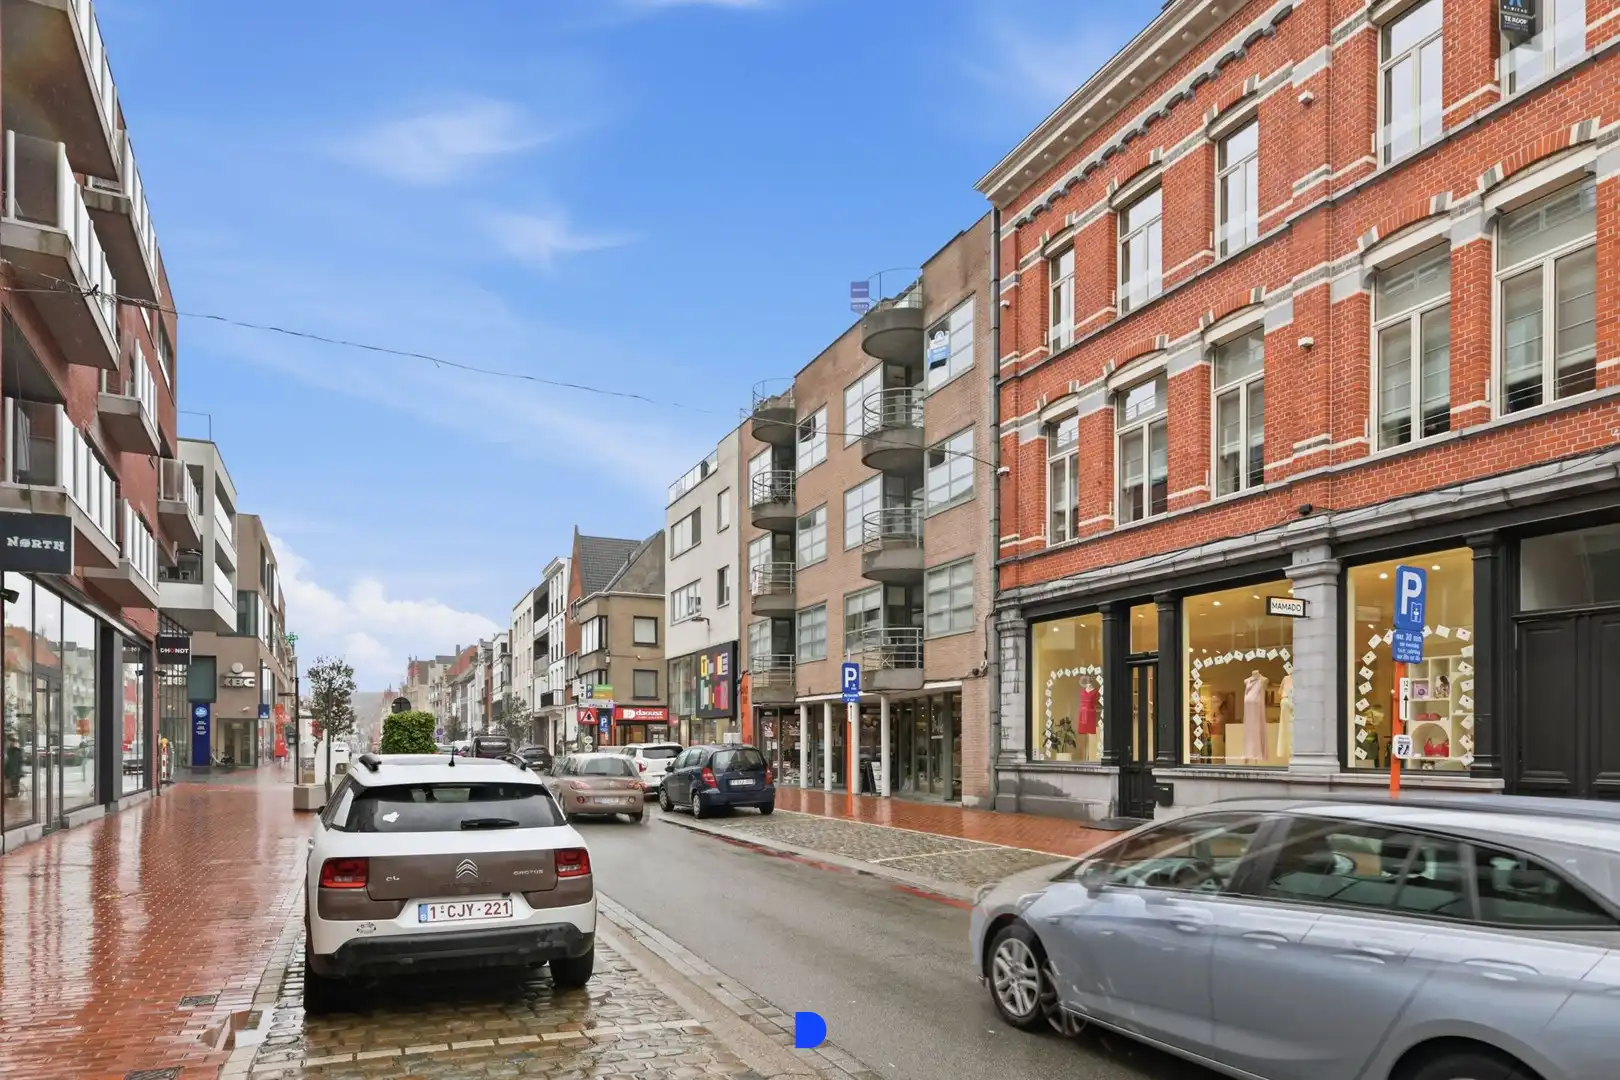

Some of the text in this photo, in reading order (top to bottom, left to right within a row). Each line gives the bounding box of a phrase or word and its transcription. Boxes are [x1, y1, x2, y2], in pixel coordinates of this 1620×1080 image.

[1401, 571, 1422, 615] P
[1271, 602, 1302, 612] MAMADO
[844, 667, 857, 688] P
[601, 717, 608, 727] P
